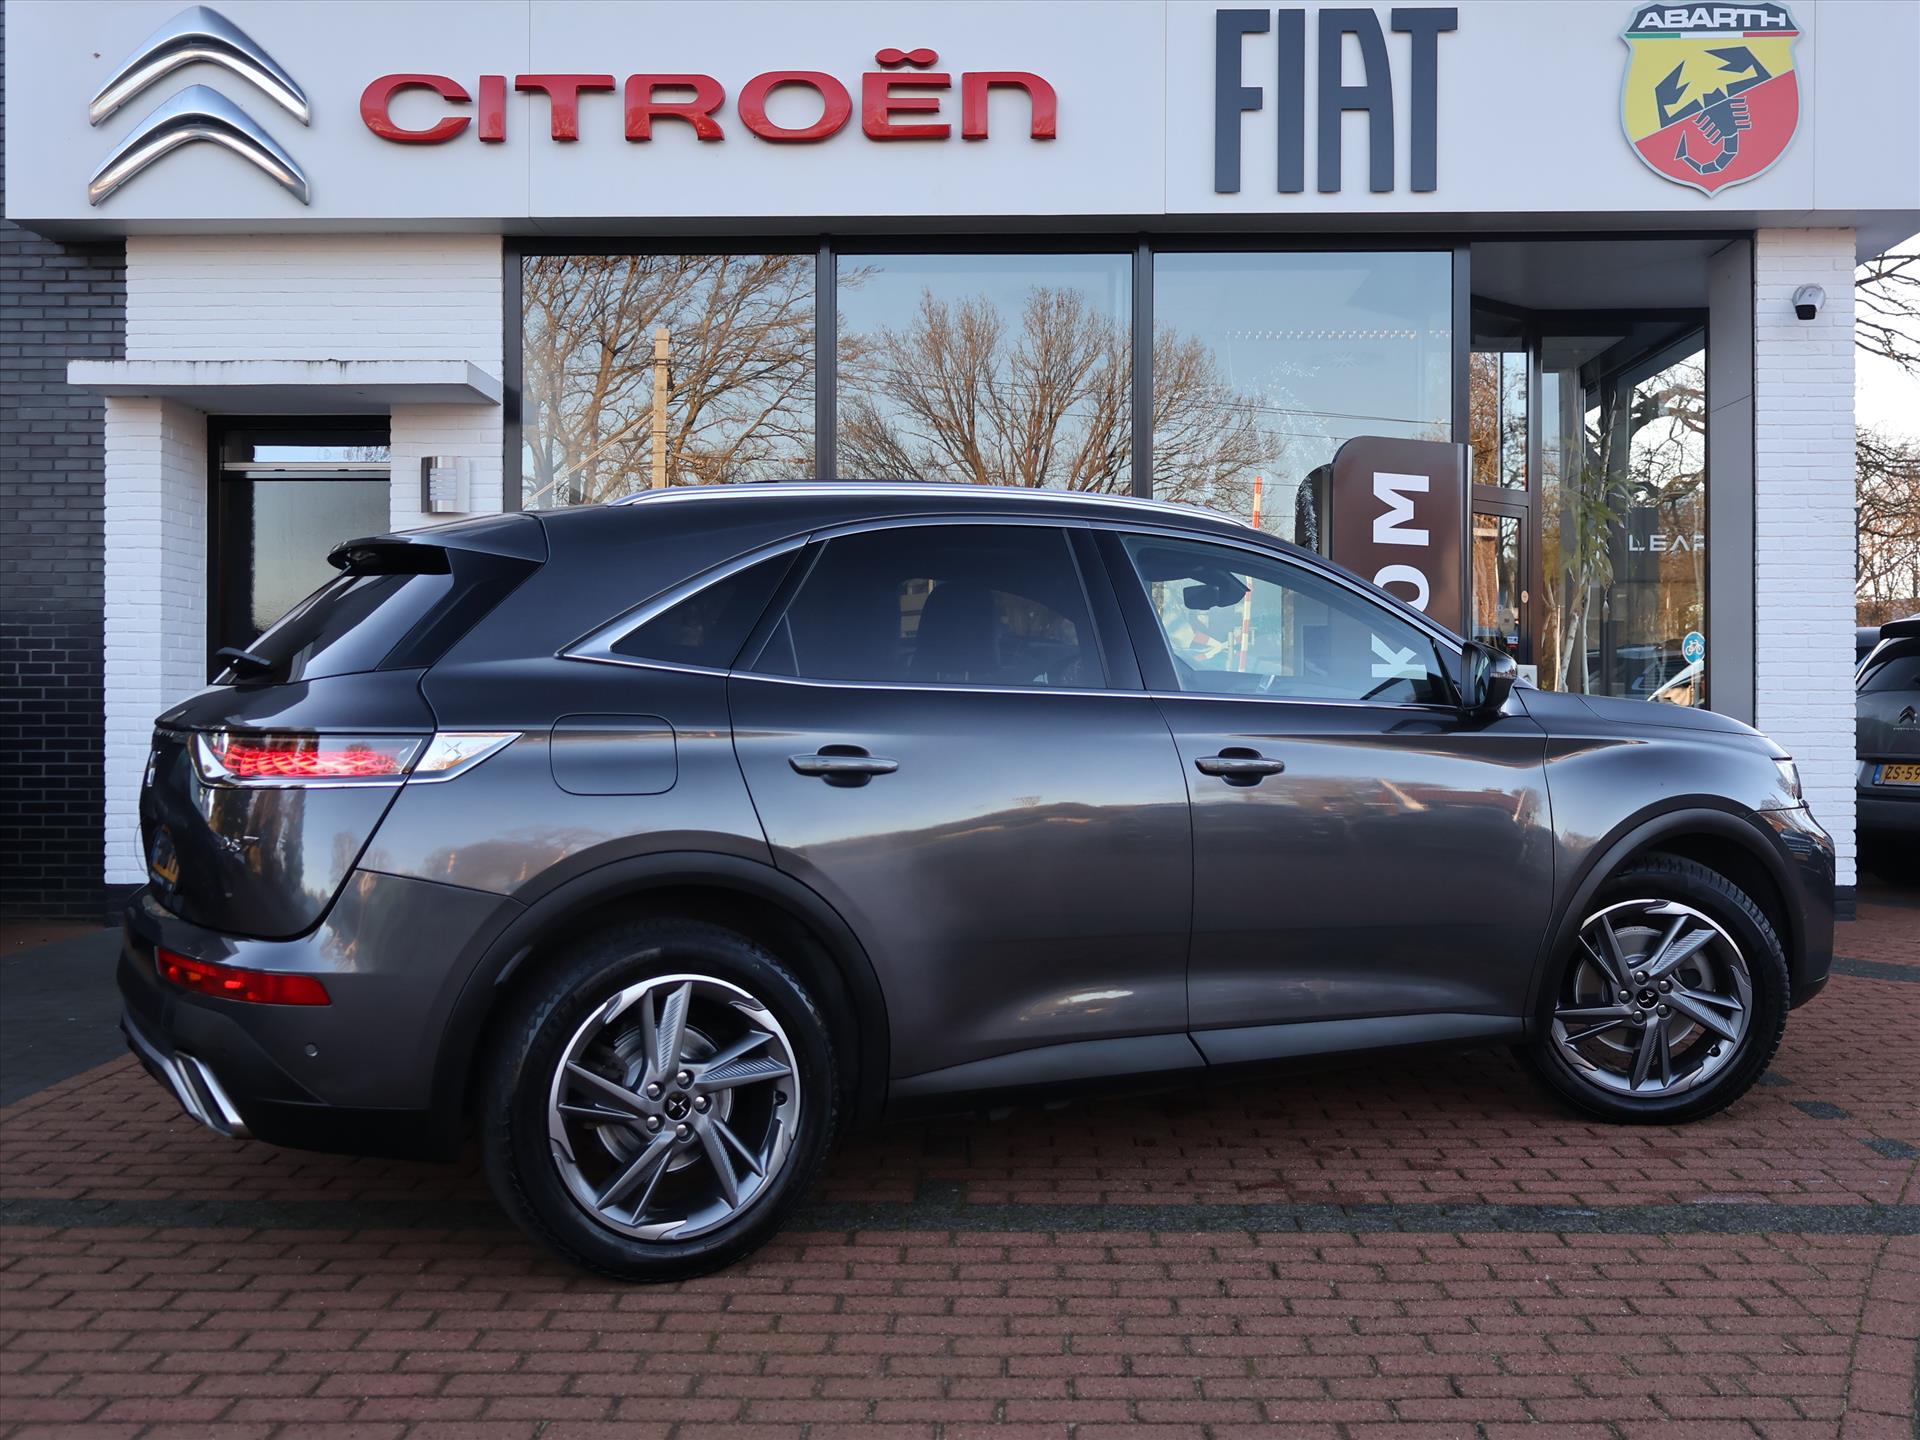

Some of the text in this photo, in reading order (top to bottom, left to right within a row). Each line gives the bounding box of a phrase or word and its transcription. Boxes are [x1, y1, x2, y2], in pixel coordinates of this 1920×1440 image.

[1637, 8, 1787, 29] ABARTH
[361, 48, 1057, 143] CITROËN
[1215, 8, 1458, 194] FIAT
